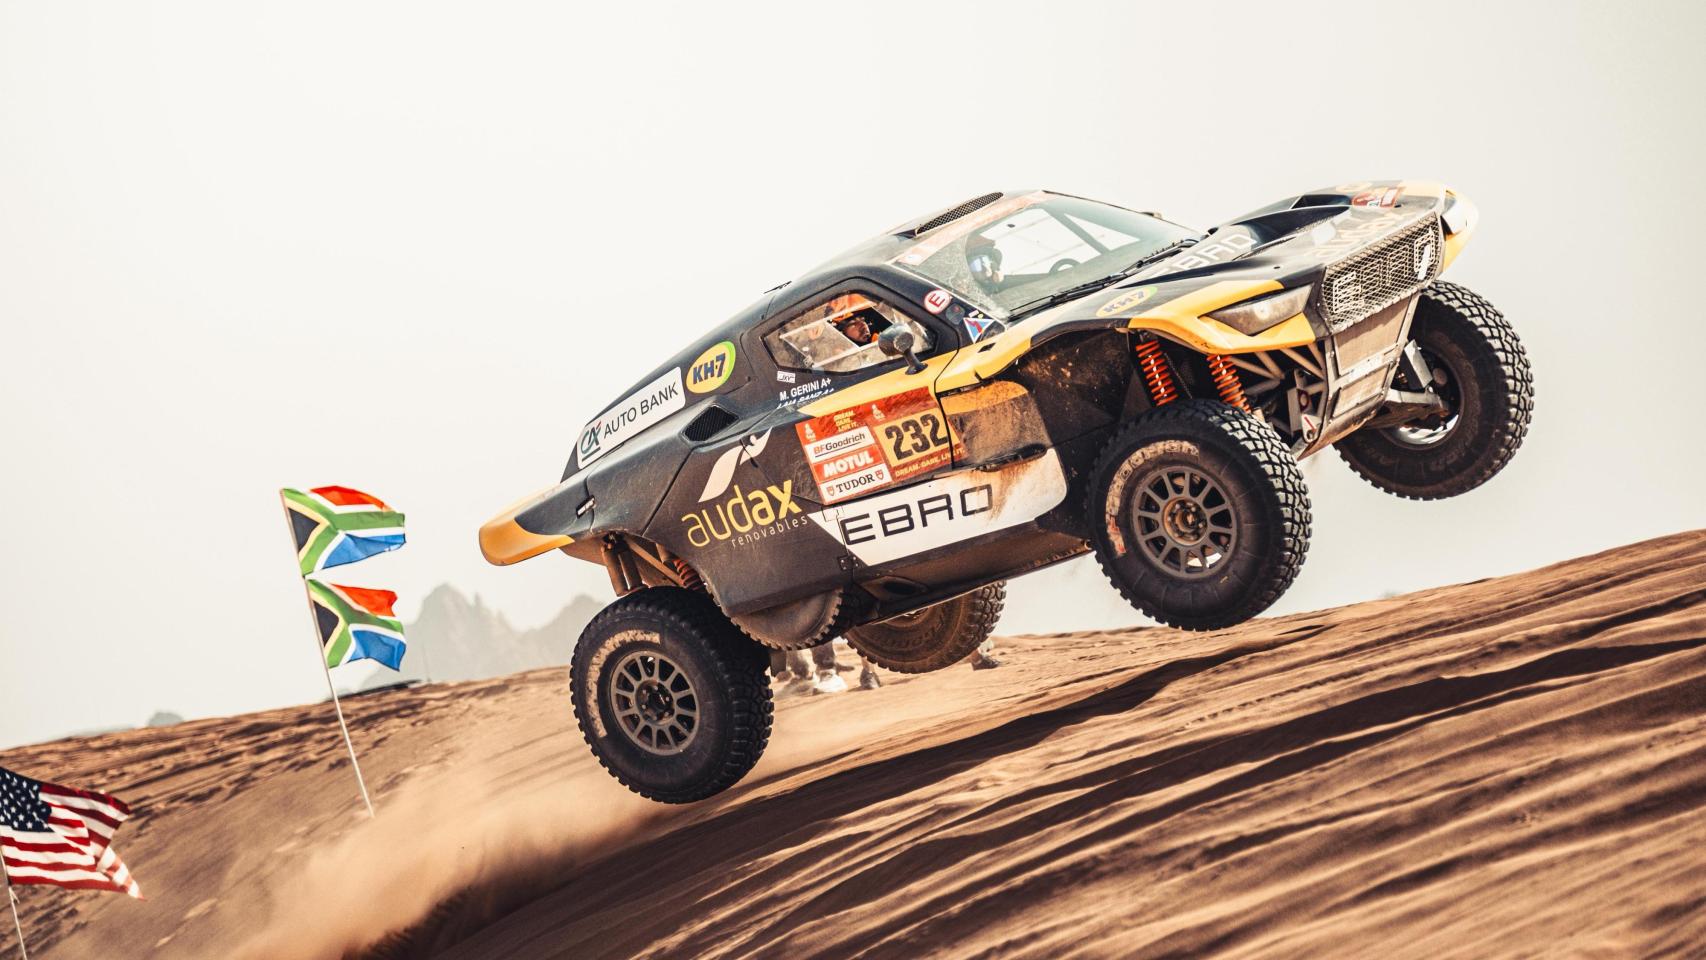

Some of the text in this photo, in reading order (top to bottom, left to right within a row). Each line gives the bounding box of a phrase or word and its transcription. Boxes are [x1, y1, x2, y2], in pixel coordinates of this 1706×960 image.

[928, 293, 946, 308] E
[780, 377, 832, 402] M. GERINI A+
[603, 407, 637, 439] AUTO
[640, 382, 679, 415] BANK
[813, 433, 866, 455] BFGoodrich
[884, 413, 949, 461] 232
[823, 450, 875, 478] MOTUL
[835, 474, 876, 493] TUDOR
[681, 479, 803, 547] audax
[839, 484, 993, 546] EBRO
[731, 515, 808, 549] renovables
